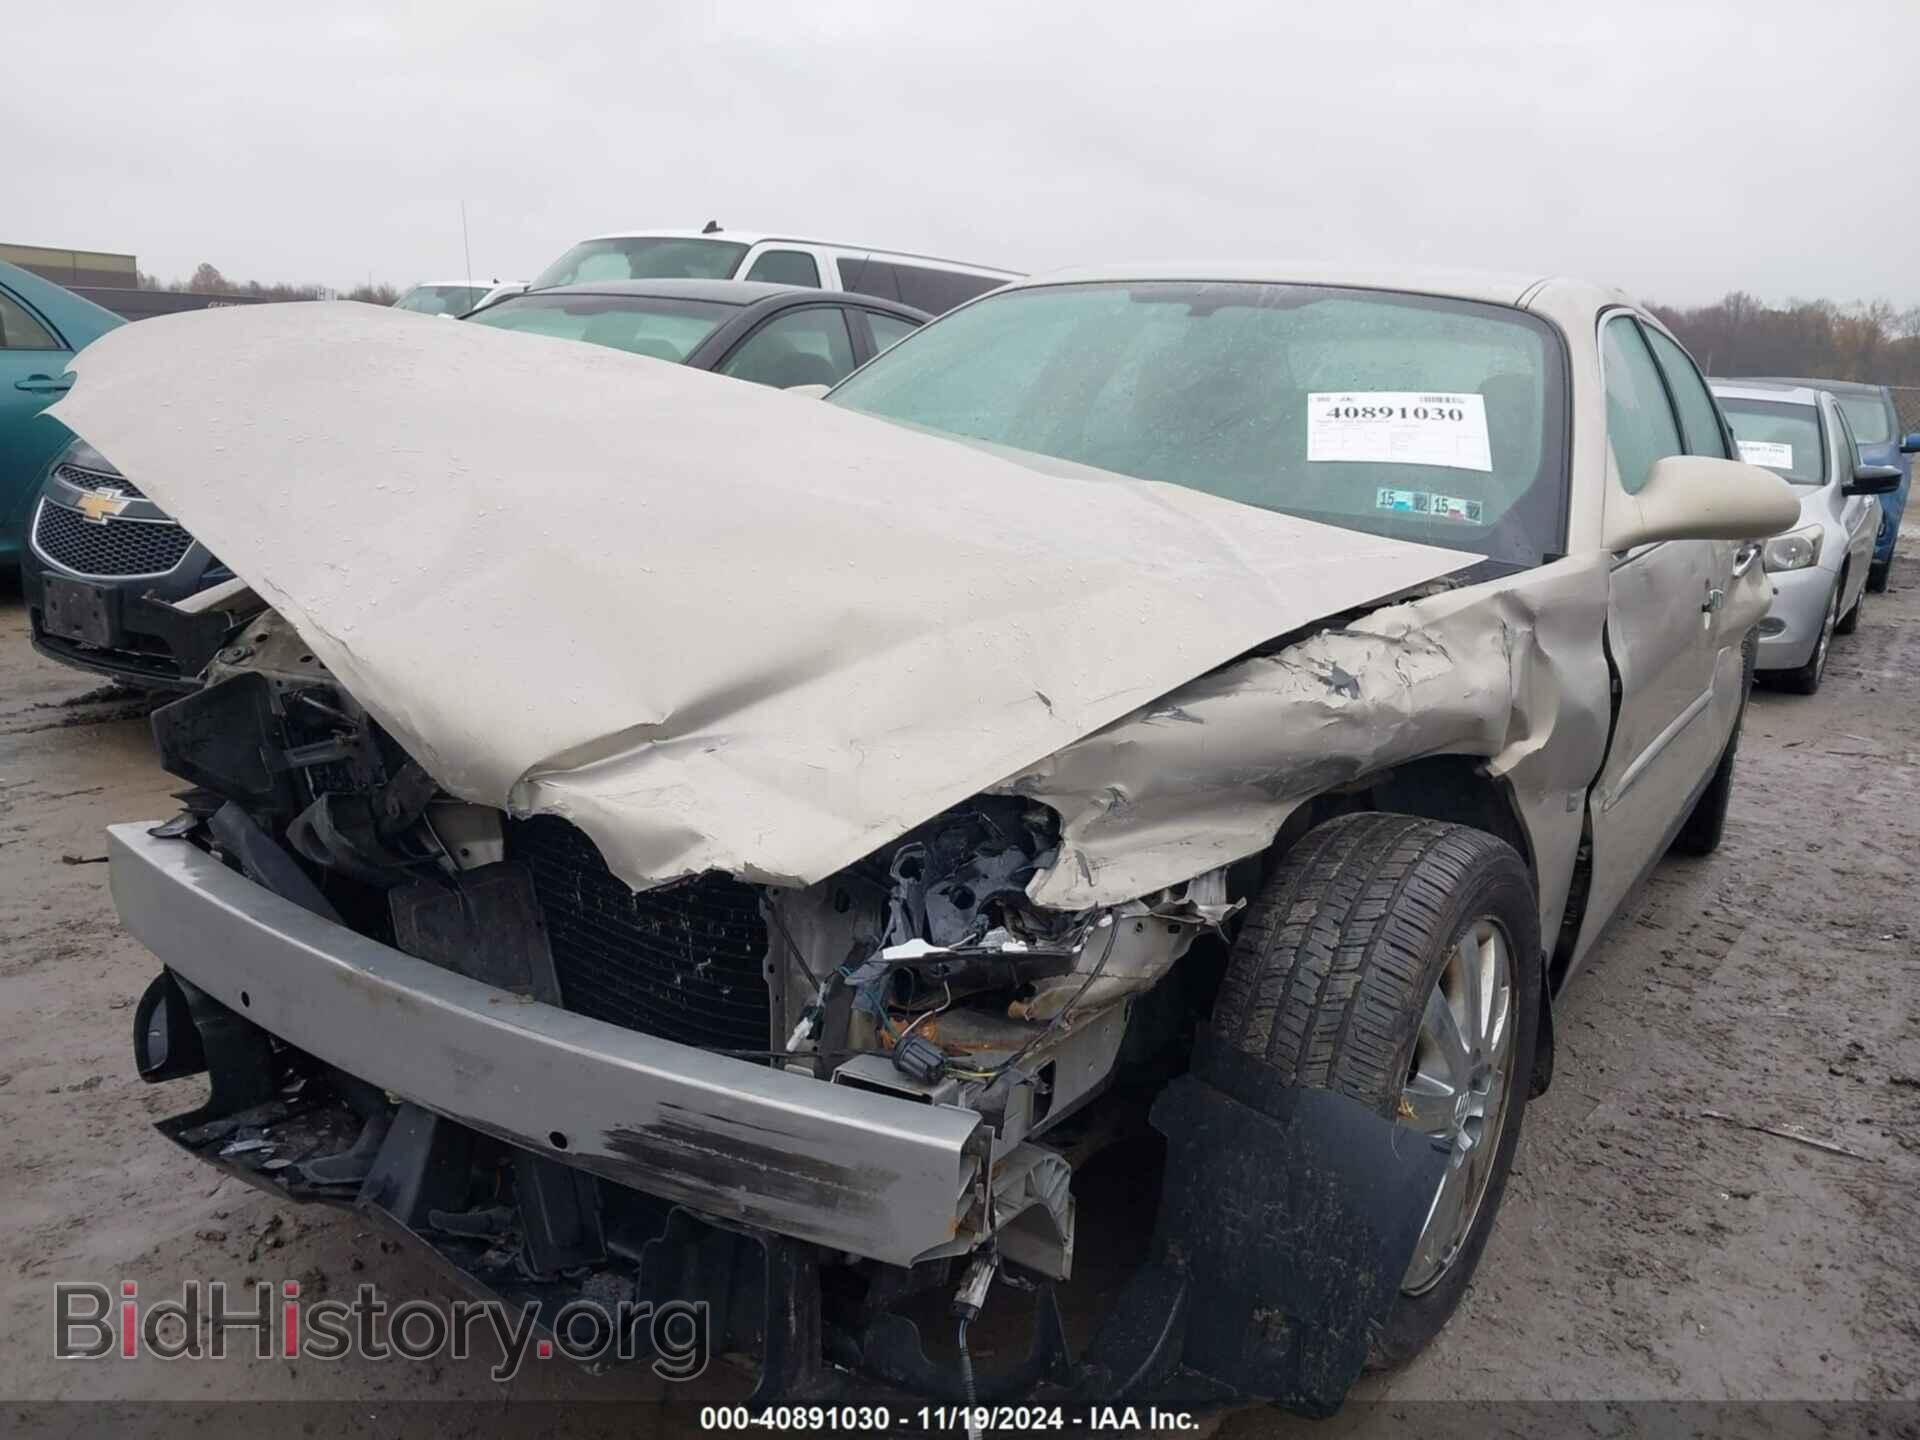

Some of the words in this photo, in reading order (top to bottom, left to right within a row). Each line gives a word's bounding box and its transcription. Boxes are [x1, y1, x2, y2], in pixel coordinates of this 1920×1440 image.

[1327, 406, 1464, 422] 40891030
[1380, 491, 1395, 506] 15
[1434, 497, 1449, 513] 15
